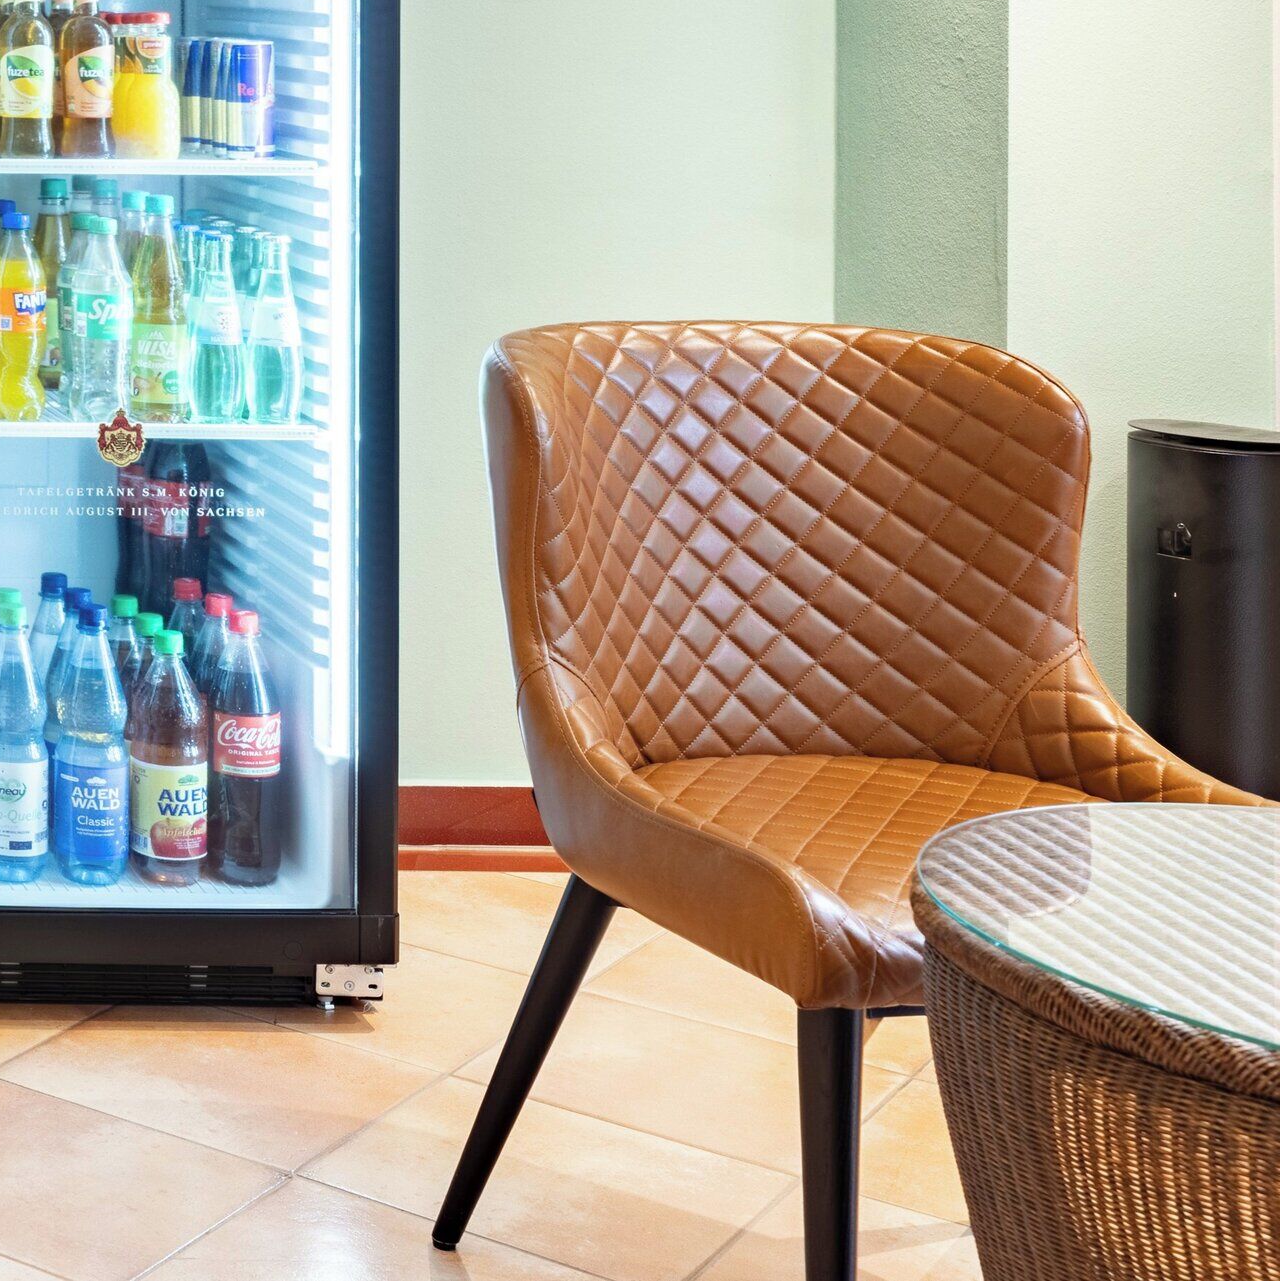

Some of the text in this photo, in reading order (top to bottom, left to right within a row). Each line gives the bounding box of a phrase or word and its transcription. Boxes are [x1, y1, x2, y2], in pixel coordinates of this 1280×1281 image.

[17, 486, 226, 497] TAFELGETRÄNK S.M. KÖNIG
[65, 507, 125, 516] AUGUST
[131, 507, 153, 516] III.
[161, 507, 190, 516] VON
[197, 507, 265, 517] SACHSEN
[228, 748, 264, 757] ORIGINAL
[72, 786, 119, 800] AUEN
[71, 796, 121, 811] WALD
[77, 815, 115, 827] Classic
